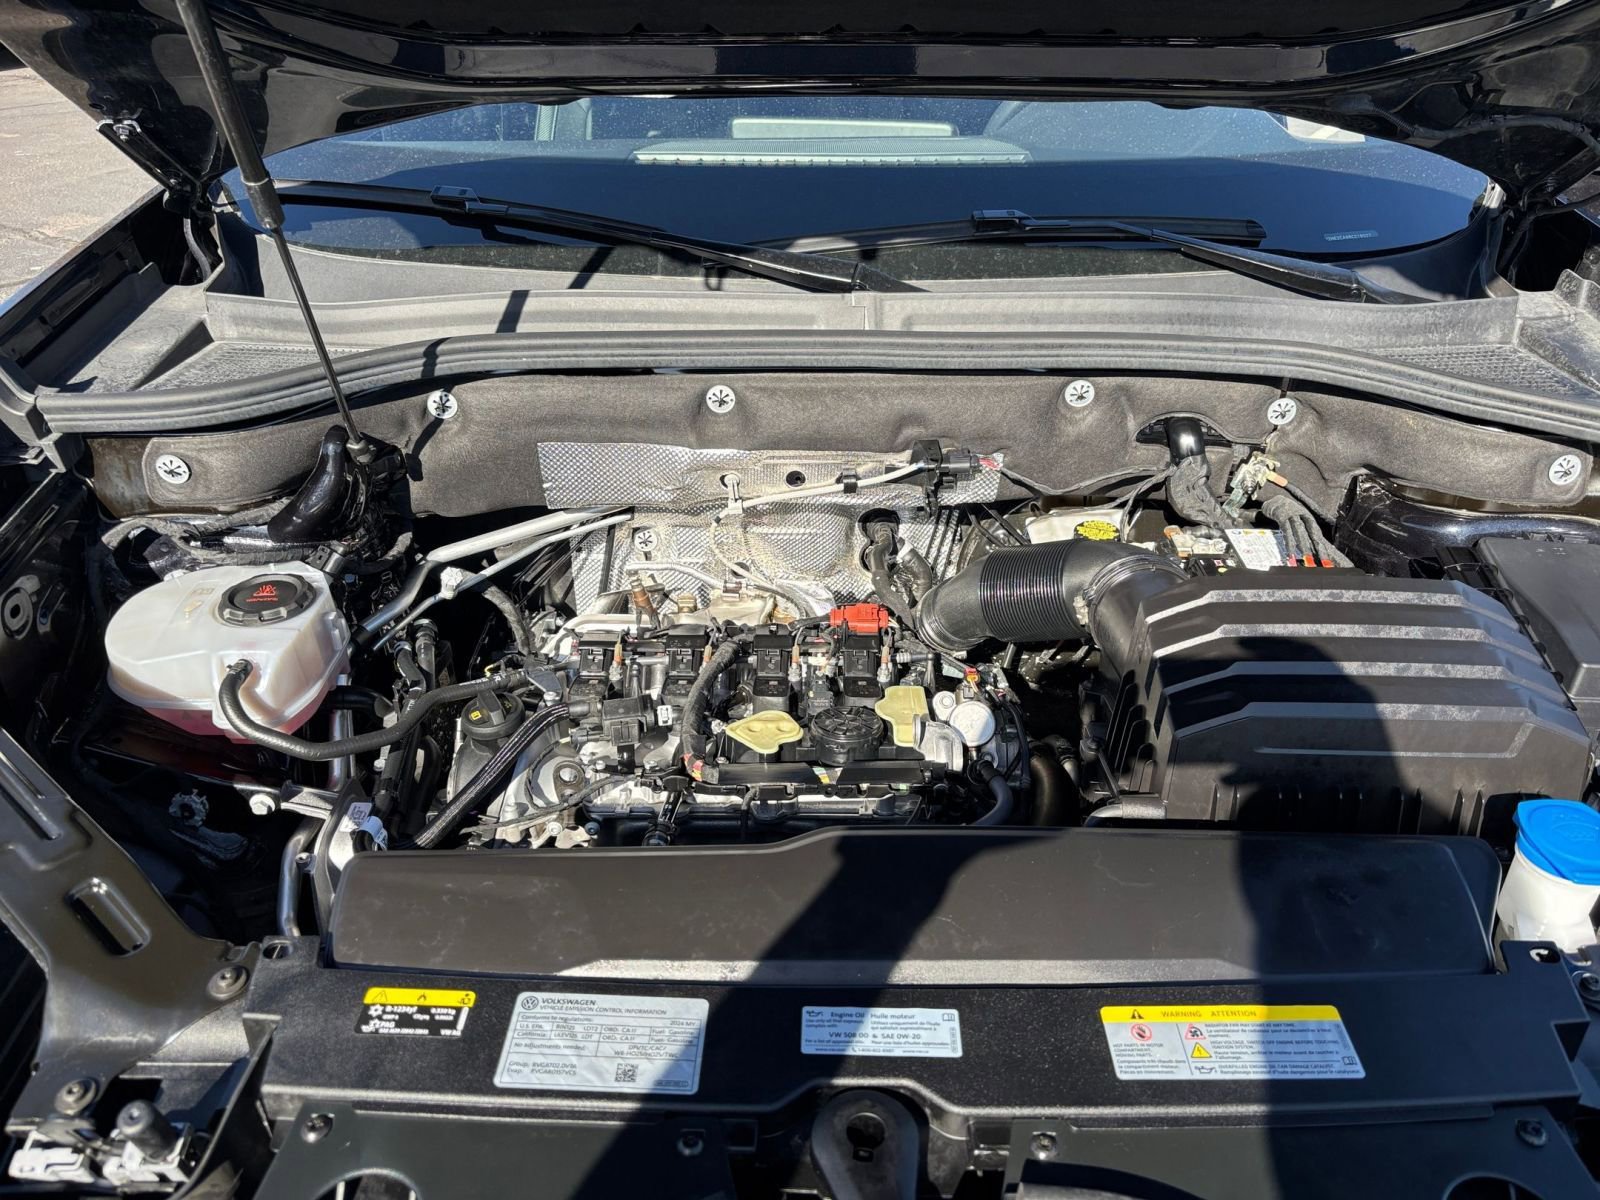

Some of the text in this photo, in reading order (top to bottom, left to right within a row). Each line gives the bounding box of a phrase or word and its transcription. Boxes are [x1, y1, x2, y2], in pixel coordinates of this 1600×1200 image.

[541, 998, 597, 1006] VOLKSWAGEN
[1161, 1010, 1257, 1018] WARNING ATTENTION
